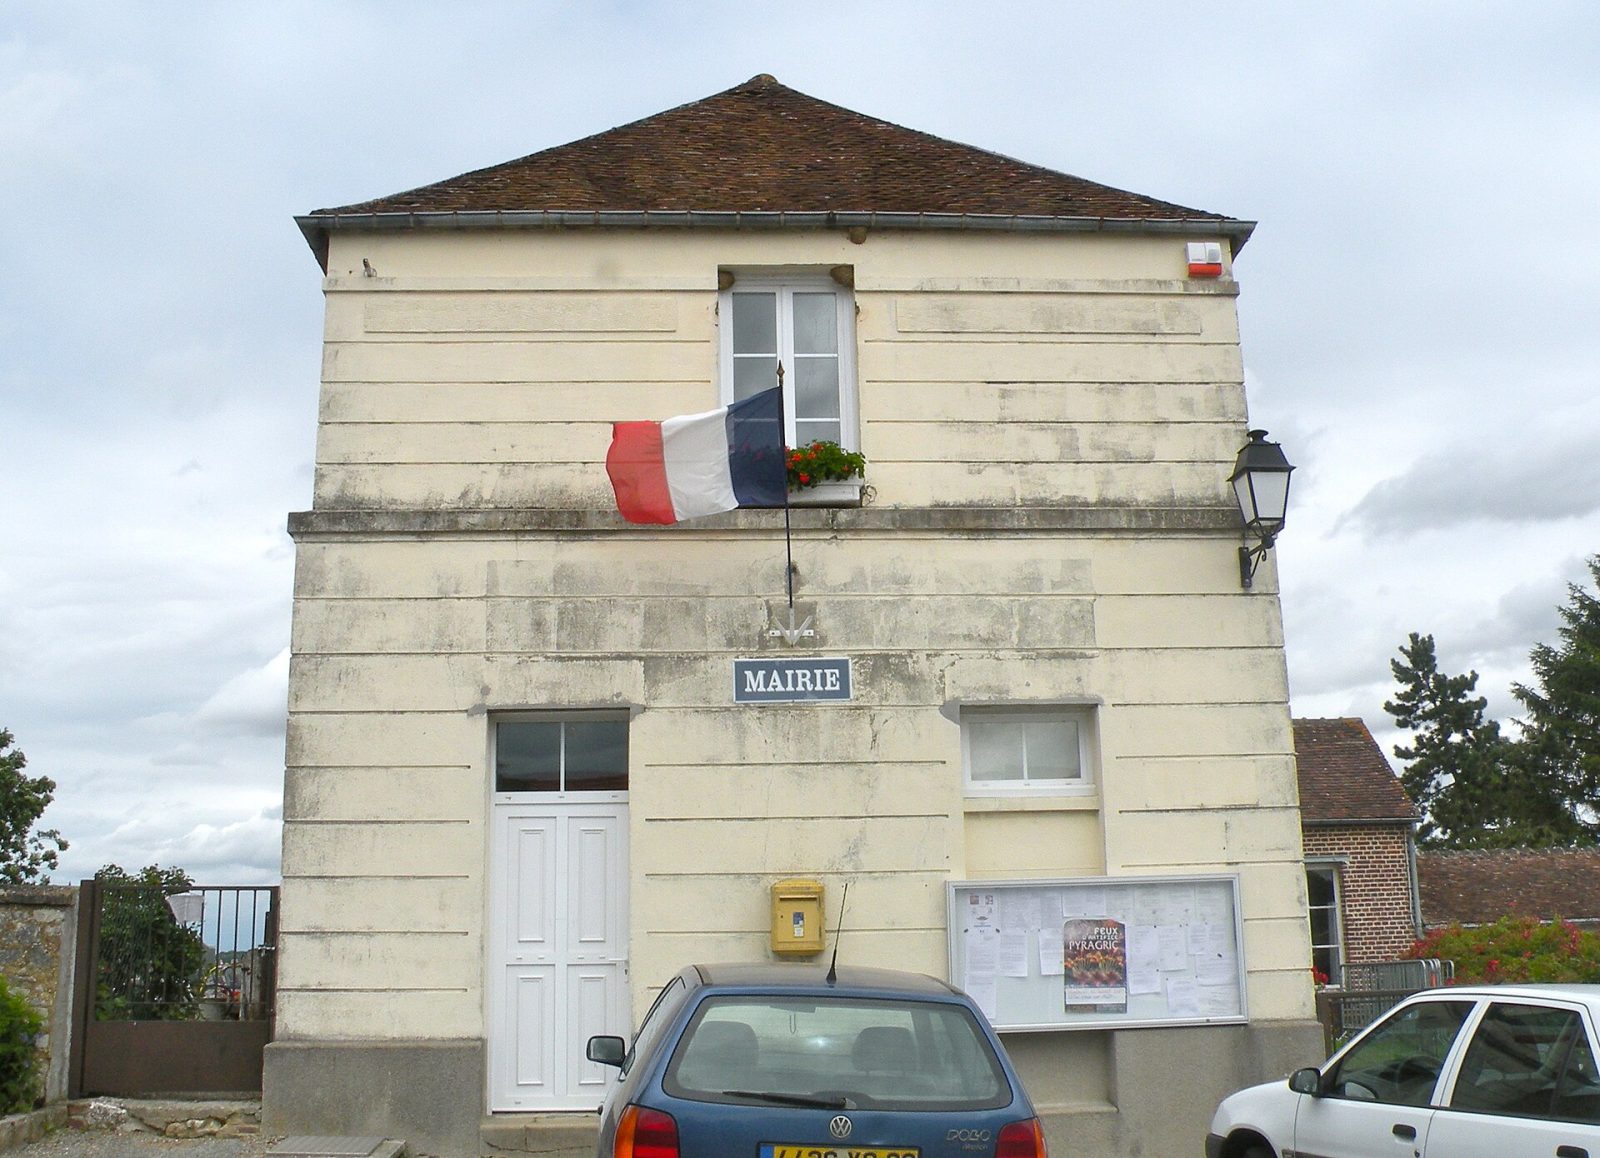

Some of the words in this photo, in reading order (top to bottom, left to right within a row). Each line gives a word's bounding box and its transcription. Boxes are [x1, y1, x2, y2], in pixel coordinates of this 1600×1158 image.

[743, 668, 841, 693] MAIRIE
[1094, 927, 1118, 935] FEUX
[1069, 940, 1119, 950] PYRAGRIC
[946, 1129, 991, 1141] POLO
